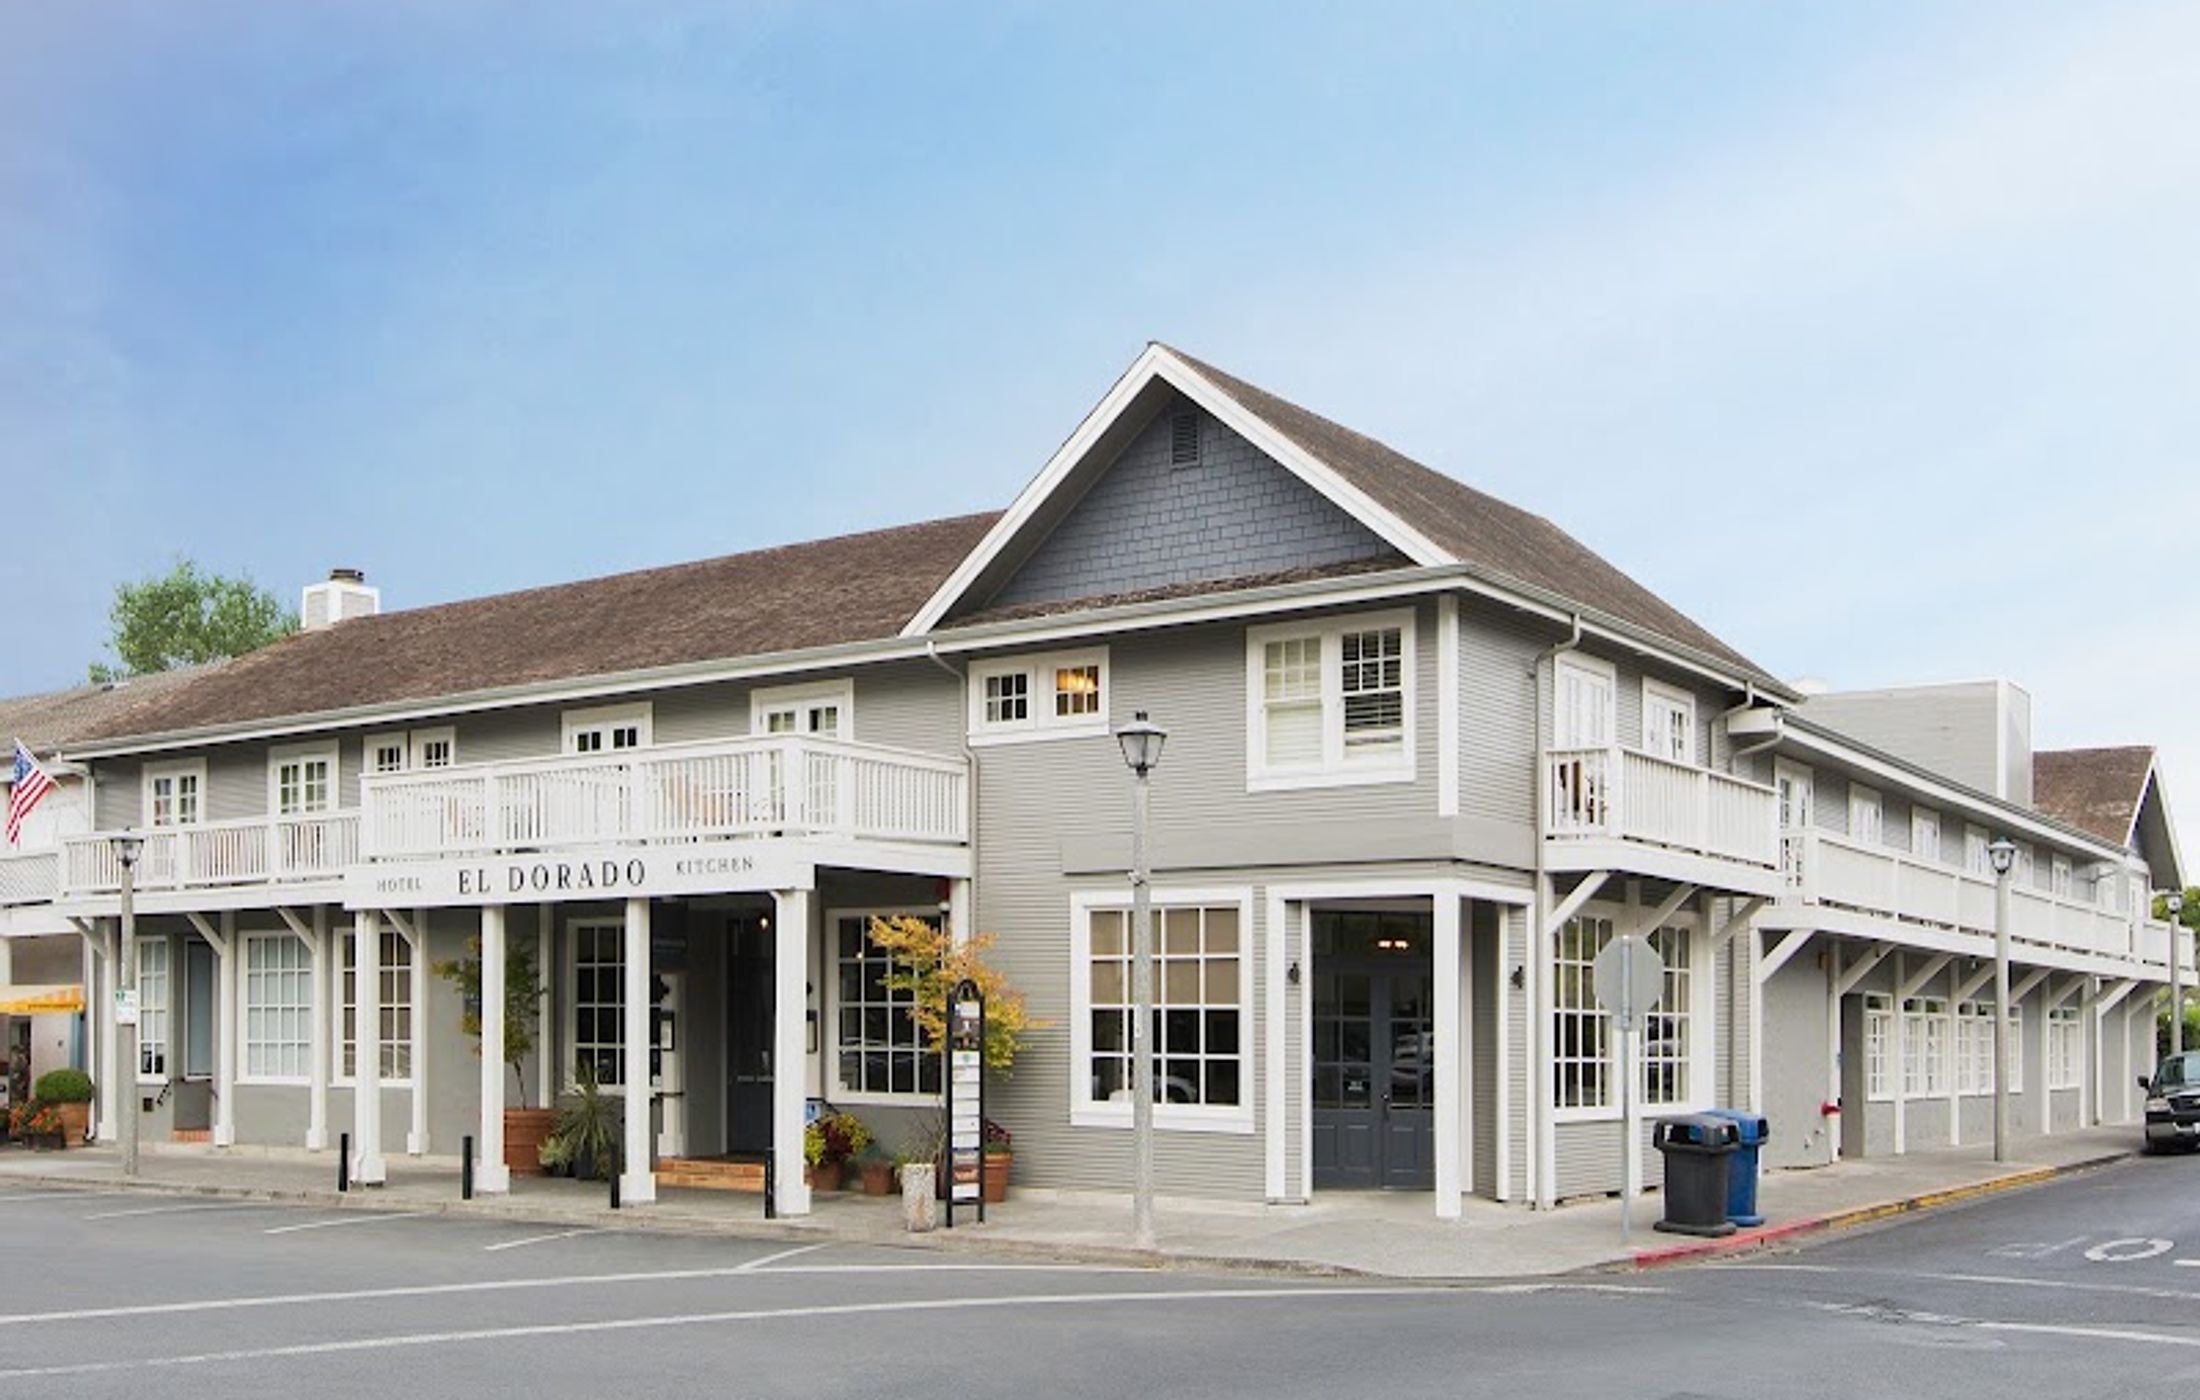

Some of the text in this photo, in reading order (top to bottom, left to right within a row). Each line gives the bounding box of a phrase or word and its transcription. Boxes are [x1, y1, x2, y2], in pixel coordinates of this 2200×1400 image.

[376, 856, 753, 895] HOTEL EL DORADO KITCHEN
